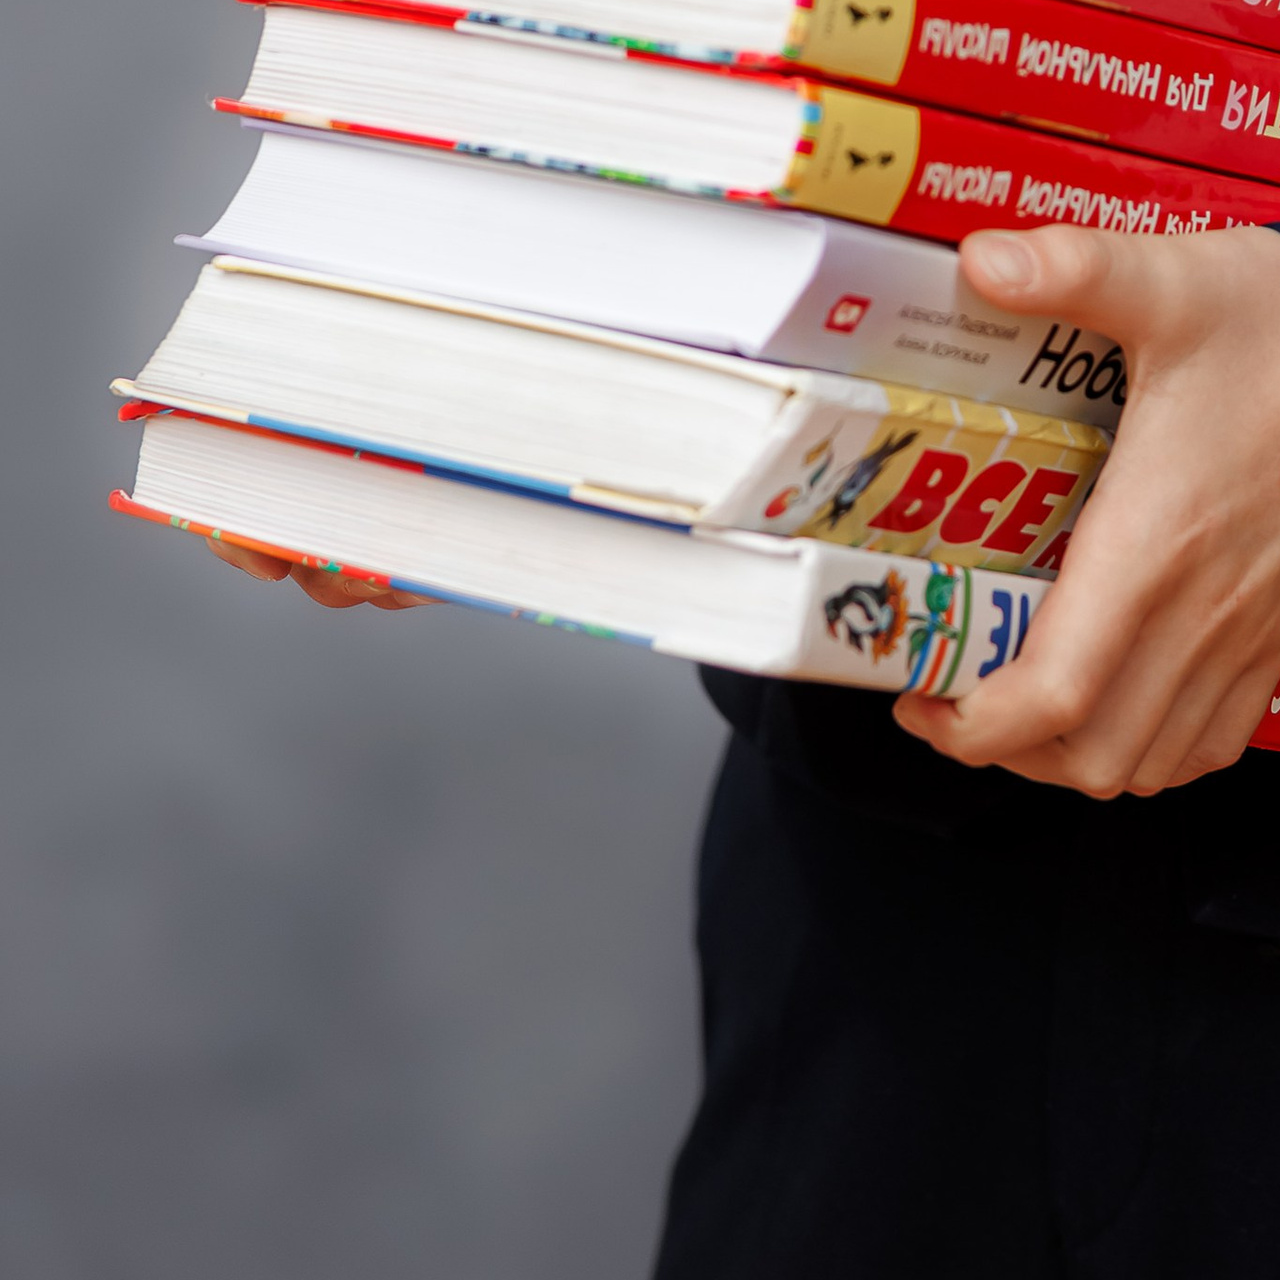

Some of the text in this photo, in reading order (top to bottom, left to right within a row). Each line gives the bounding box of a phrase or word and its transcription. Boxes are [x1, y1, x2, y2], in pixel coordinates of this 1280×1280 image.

[919, 18, 1010, 63] ШКОЛЫ
[1017, 33, 1161, 101] НАЧАЛЬНОЙ
[918, 162, 1012, 205] ШКОЛЫ
[1016, 175, 1161, 235] НАЧАЛЬНОЙ
[867, 449, 1080, 555] ВСЕ
